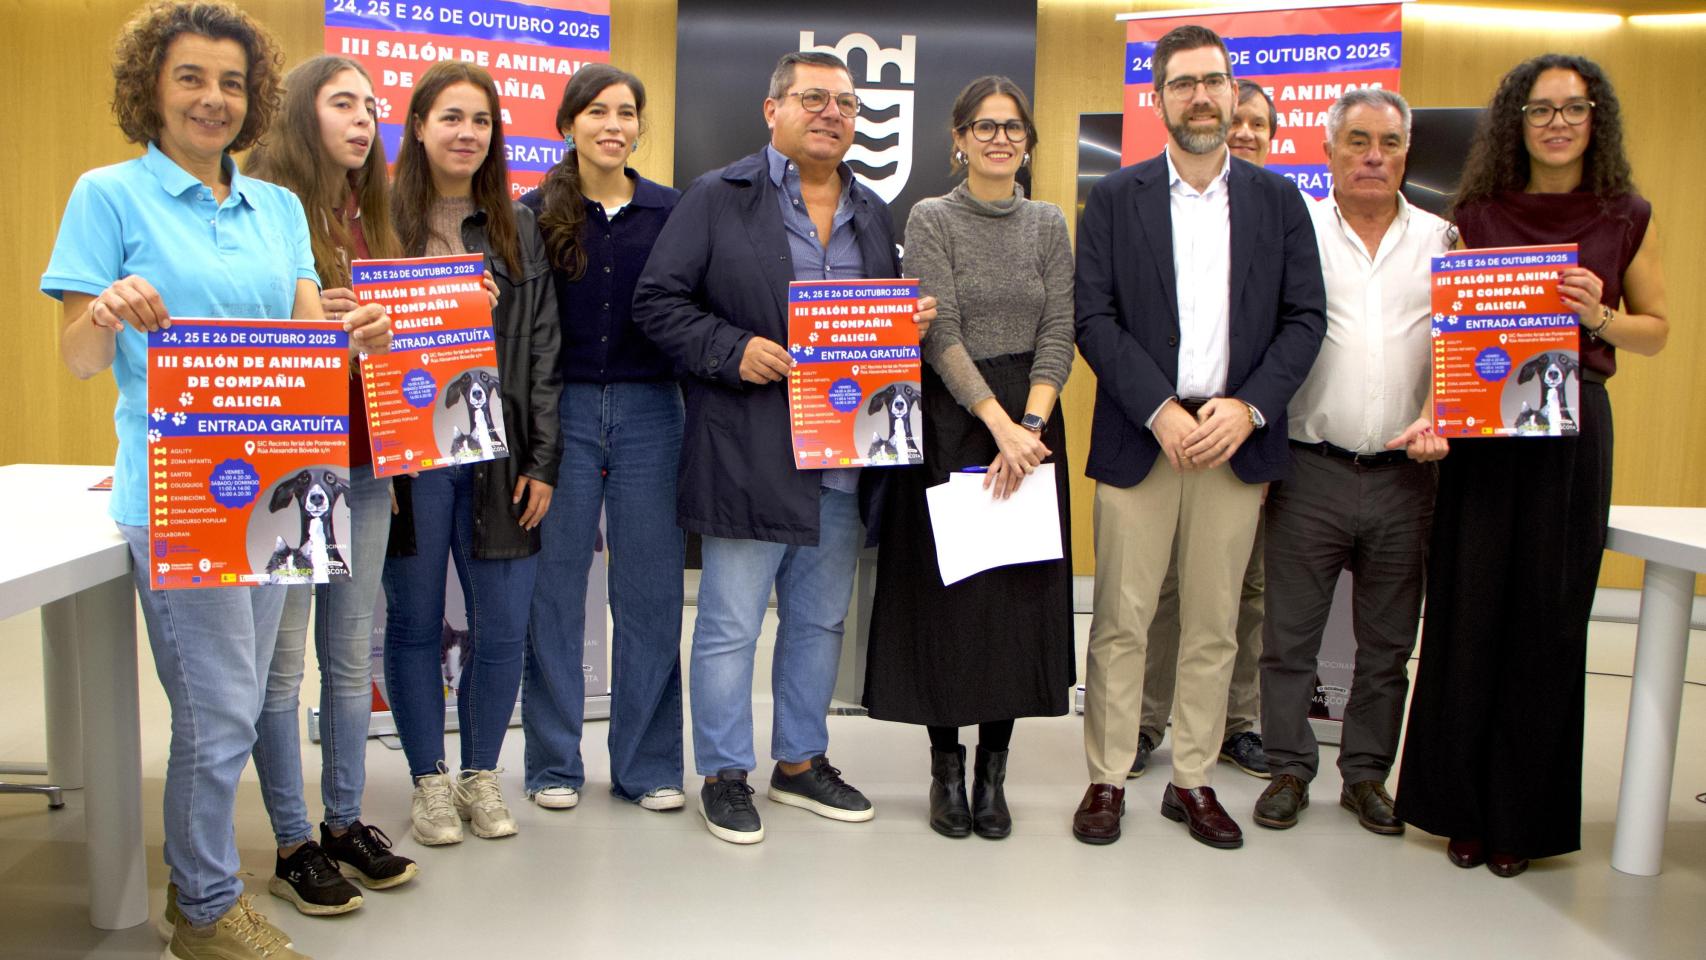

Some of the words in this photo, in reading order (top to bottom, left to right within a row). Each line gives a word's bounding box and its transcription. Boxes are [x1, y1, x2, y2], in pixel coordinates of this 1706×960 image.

[333, 0, 362, 16] 24,
[368, 1, 390, 16] 25
[396, 3, 407, 19] E
[412, 5, 434, 21] 26
[440, 8, 463, 25] DE
[469, 11, 554, 34] OUTUBRO
[559, 21, 600, 39] 2025
[342, 37, 369, 55] III
[376, 42, 453, 62] SALÓN
[460, 48, 489, 67] DE
[495, 53, 592, 76] ANIMAI
[1132, 57, 1153, 71] 24
[1230, 51, 1250, 65] DE
[1255, 46, 1341, 64] OUTUBRO
[1346, 42, 1391, 59] 2025
[383, 70, 413, 88] DE
[504, 144, 565, 164] GRATU
[1440, 260, 1454, 269] 24,
[1455, 260, 1466, 268] 25
[1468, 259, 1473, 267] E
[1475, 258, 1486, 266] 26
[1488, 258, 1499, 266] DE
[1501, 256, 1544, 265] OUTUBRO
[1545, 254, 1568, 263] 2025
[360, 271, 372, 281] 24,
[373, 271, 383, 279] 25
[384, 271, 388, 279] E
[389, 270, 398, 278] 26
[400, 269, 410, 278] DE
[411, 266, 453, 277] OUTUBRO
[454, 264, 475, 274] 2025
[1437, 277, 1451, 286] III
[1454, 273, 1494, 285] SALÓN
[1497, 274, 1513, 283] DE
[1516, 271, 1559, 281] ANIMA
[359, 290, 371, 300] III
[374, 287, 407, 299] SALÓN
[410, 286, 426, 297] DE
[428, 281, 481, 295] ANIMAIS
[798, 290, 811, 299] 24,
[812, 290, 822, 298] 25
[831, 289, 841, 298] 26
[842, 289, 853, 297] DE
[855, 288, 891, 297] OUTUBRO
[892, 288, 910, 296] 2025
[1458, 289, 1474, 298] DE
[1476, 285, 1545, 298] COMPAÑIA
[394, 299, 458, 313] COMPAÑIA
[795, 307, 809, 316] III
[811, 305, 849, 316] SALÓN
[851, 305, 865, 314] DE
[868, 304, 913, 314] ANIMAIS
[1475, 300, 1527, 311] GALICIA
[395, 316, 443, 329] GALICIA
[815, 321, 829, 329] DE
[832, 317, 893, 329] COMPAÑIA
[1466, 318, 1516, 329] ENTRADA
[1518, 313, 1575, 327] GRATUÍTA
[162, 332, 182, 345] 24,
[185, 333, 199, 343] 25
[203, 333, 209, 343] E
[213, 333, 227, 343] 26
[231, 333, 246, 343] DE
[250, 333, 305, 344] OUTUBRO
[309, 334, 336, 344] 2025
[391, 335, 435, 350] ENTRADA
[437, 329, 491, 345] GRATUÍTA
[830, 333, 877, 343] GALICIA
[821, 350, 867, 360] ENTRADA
[870, 346, 917, 359] GRATUÍTA
[157, 356, 178, 368] III
[183, 354, 239, 368] SALÓN
[243, 357, 264, 368] DE
[269, 357, 341, 368] ANIMAIS
[188, 376, 209, 387] DE
[214, 374, 305, 388] COMPAÑIA
[212, 396, 282, 407] GALICIA
[198, 419, 267, 433] ENTRADA
[271, 416, 344, 432] GRATUÍTA
